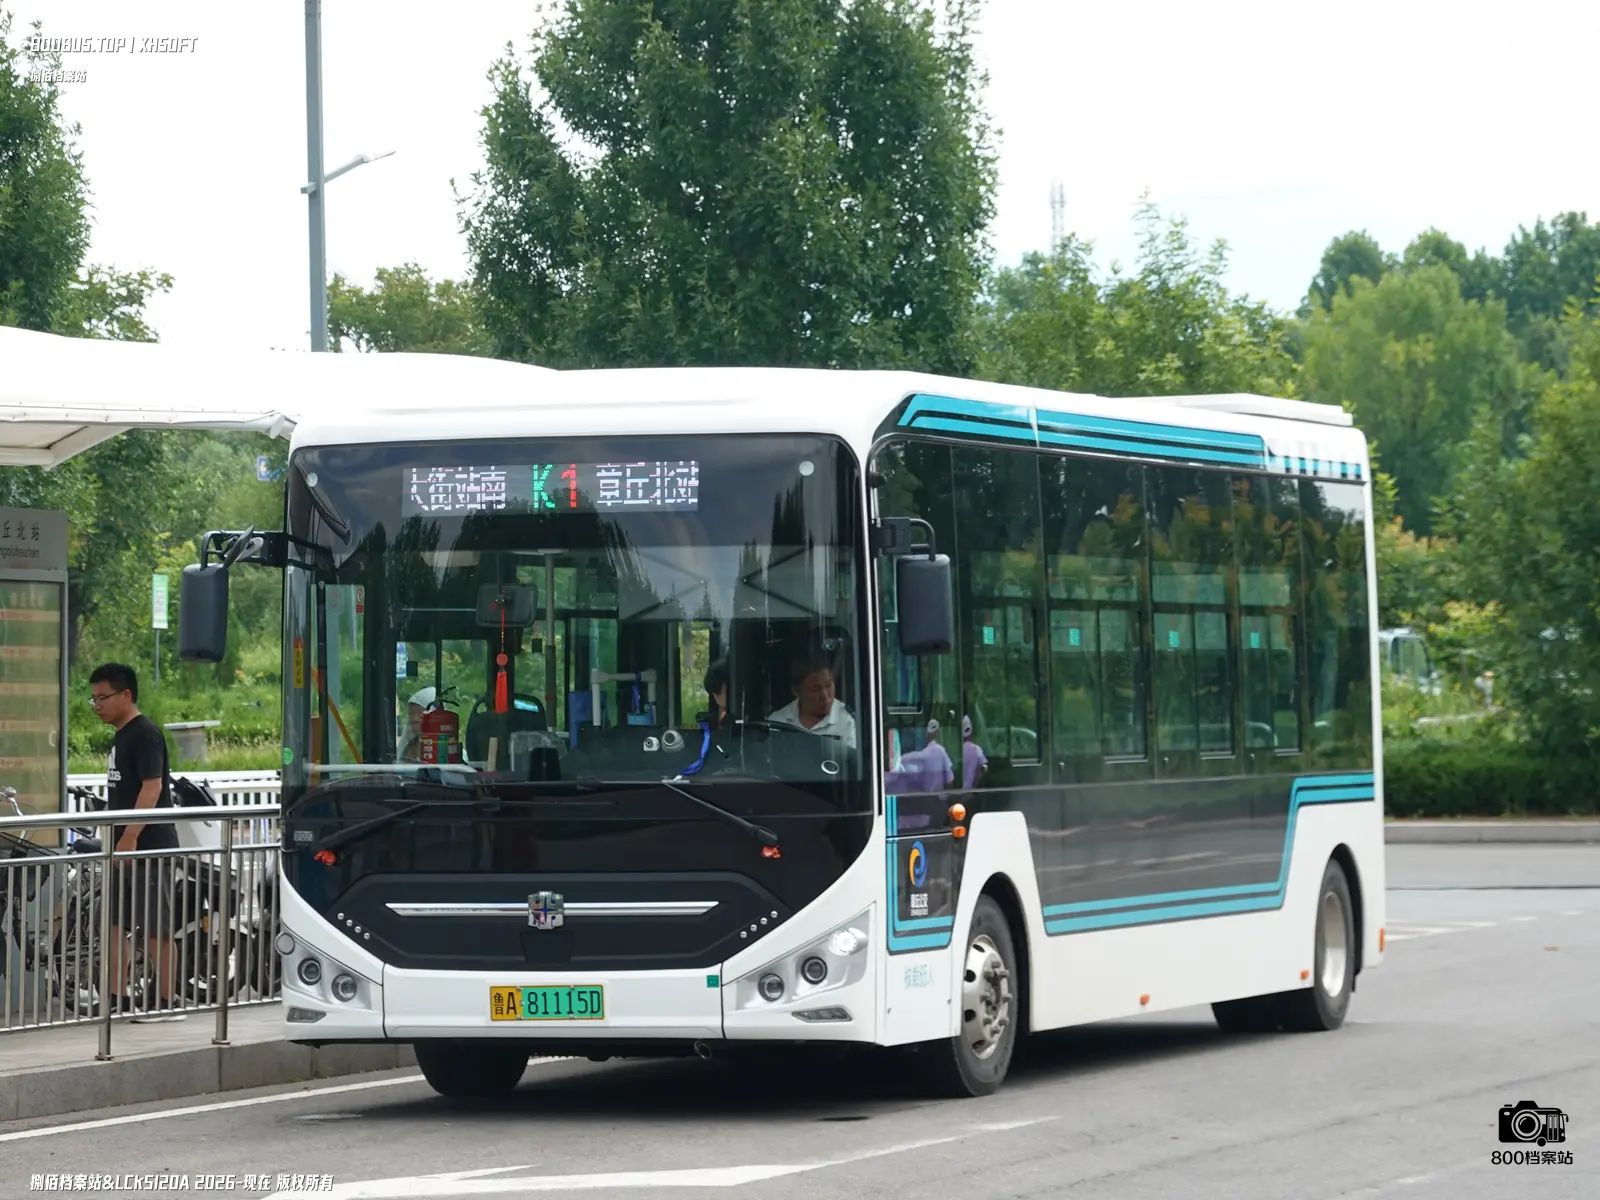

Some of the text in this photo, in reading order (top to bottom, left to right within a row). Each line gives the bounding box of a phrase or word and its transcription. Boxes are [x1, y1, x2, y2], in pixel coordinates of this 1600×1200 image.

[533, 463, 577, 509] K1
[2, 519, 39, 541] 丘北站
